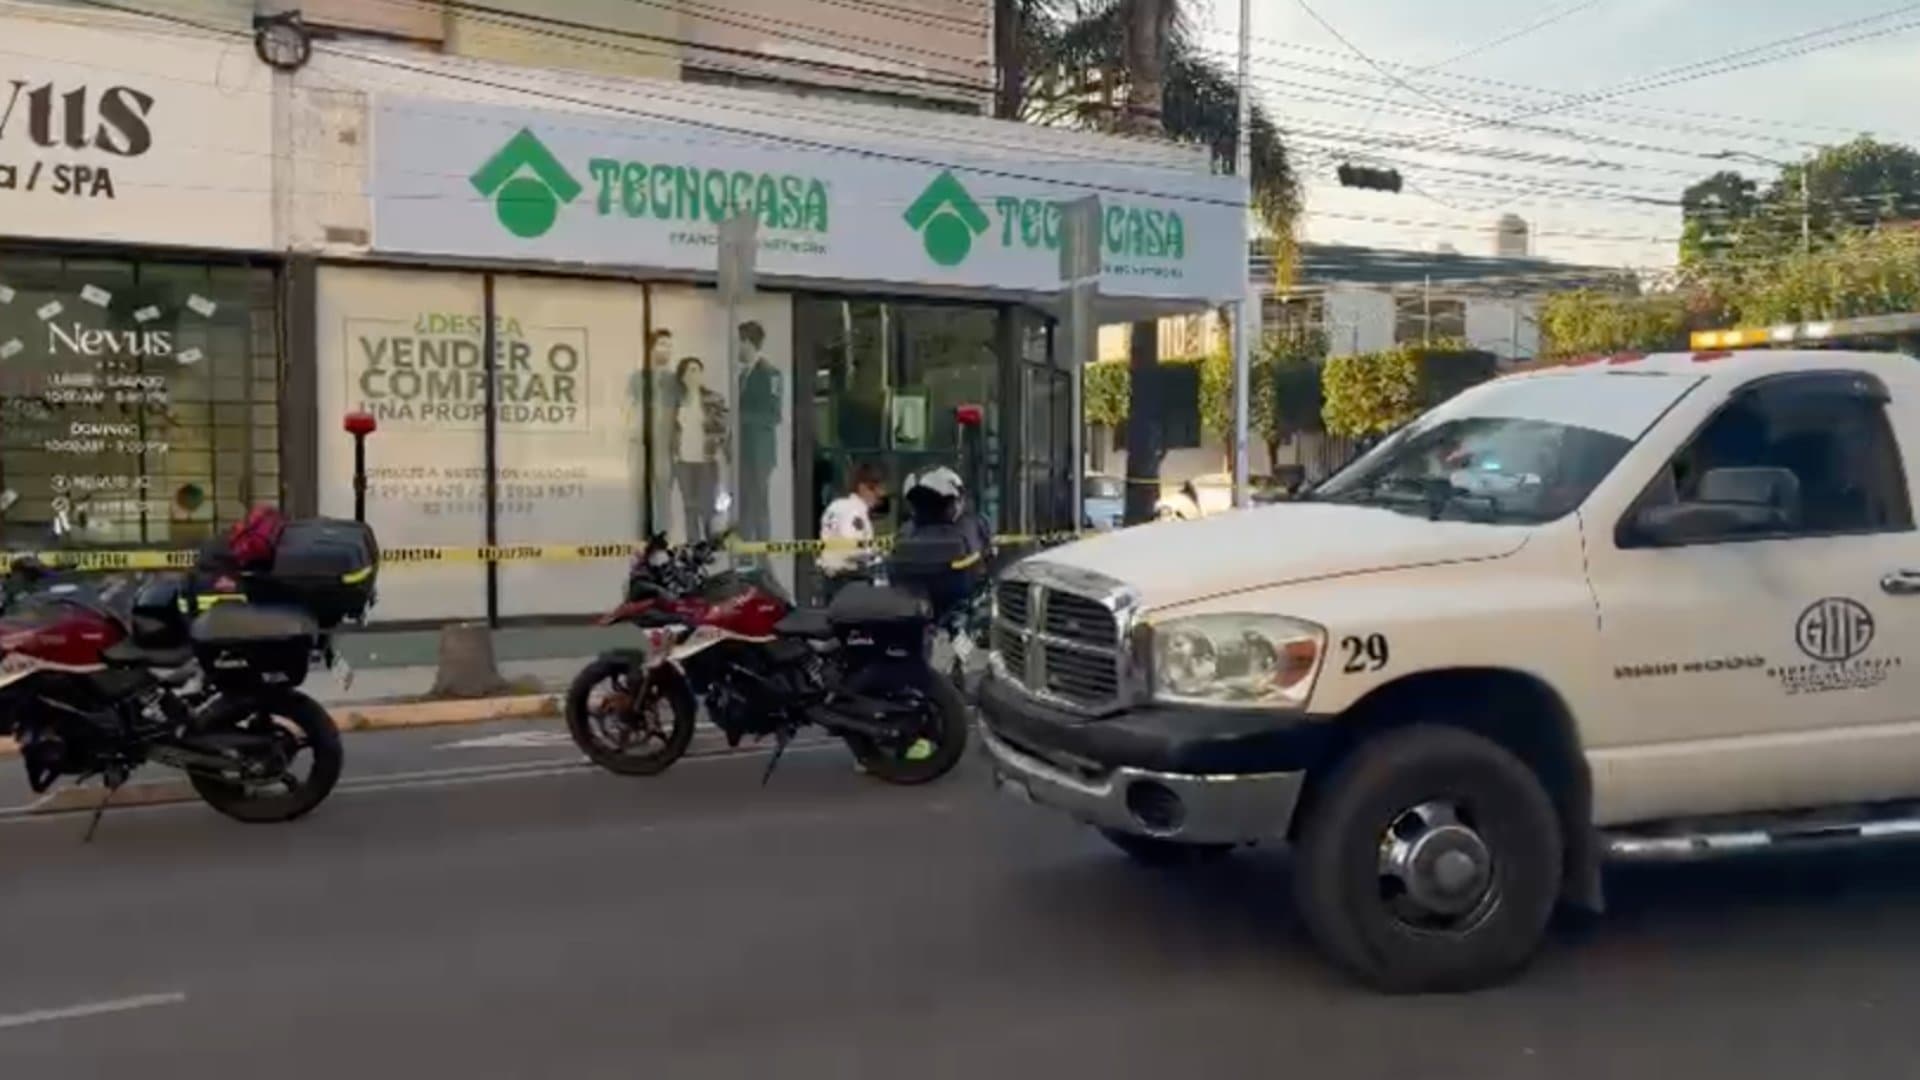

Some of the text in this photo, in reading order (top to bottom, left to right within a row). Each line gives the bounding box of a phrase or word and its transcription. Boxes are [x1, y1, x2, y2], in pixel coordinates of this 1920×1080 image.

[52, 164, 115, 199] SPA
[588, 158, 829, 233] TECNOCASA
[996, 196, 1185, 260] TECCASA
[48, 321, 173, 356] Nevus
[413, 311, 524, 336] ¿DESEA
[359, 336, 578, 373] VENDER O
[359, 368, 576, 403] COMPRAR
[421, 403, 577, 424] PROPEDAD?
[1341, 632, 1389, 674] 29
